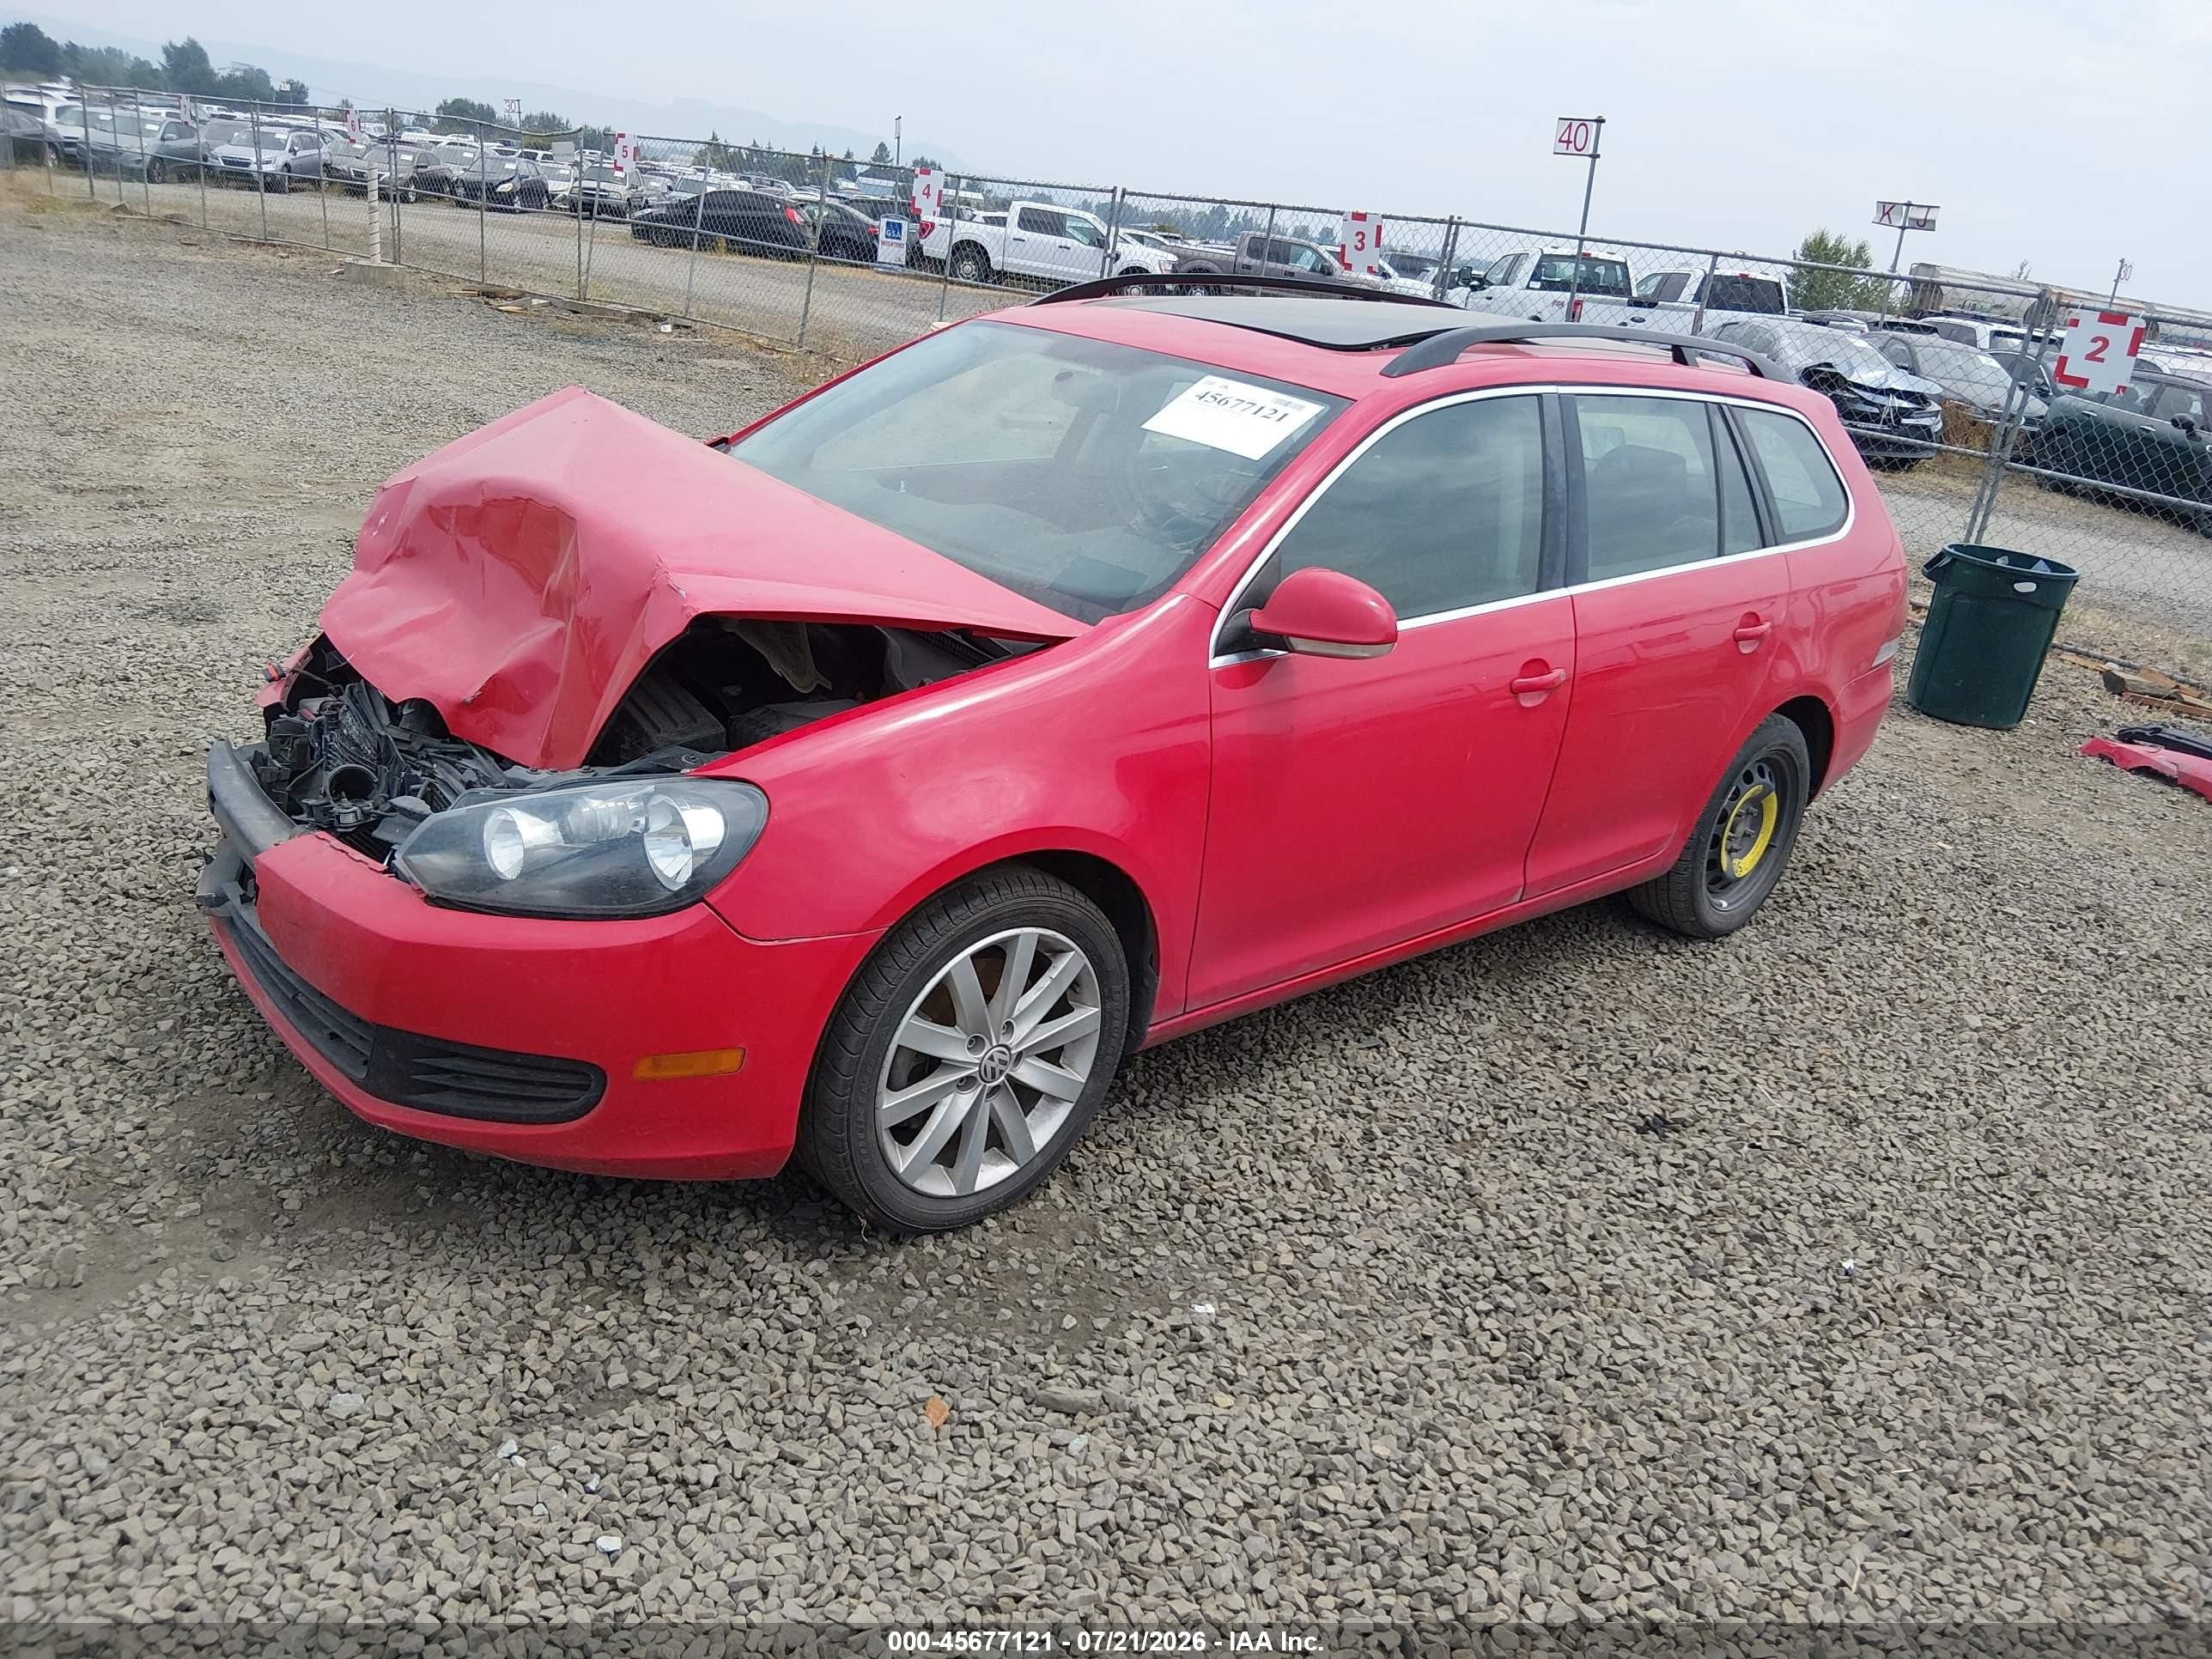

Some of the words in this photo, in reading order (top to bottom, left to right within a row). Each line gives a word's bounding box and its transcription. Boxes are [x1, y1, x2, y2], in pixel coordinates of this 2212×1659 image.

[504, 100, 516, 112] 30
[350, 119, 356, 131] 6
[1558, 121, 1589, 152] 40
[621, 144, 629, 159] 5
[922, 183, 931, 199] 4
[1879, 204, 1896, 224] K
[1916, 206, 1931, 228] J
[886, 229, 901, 238] GSA
[1354, 230, 1366, 252] 3
[2118, 263, 2133, 282] 30
[2084, 336, 2110, 363] 2
[1194, 391, 1289, 422] 45677121
